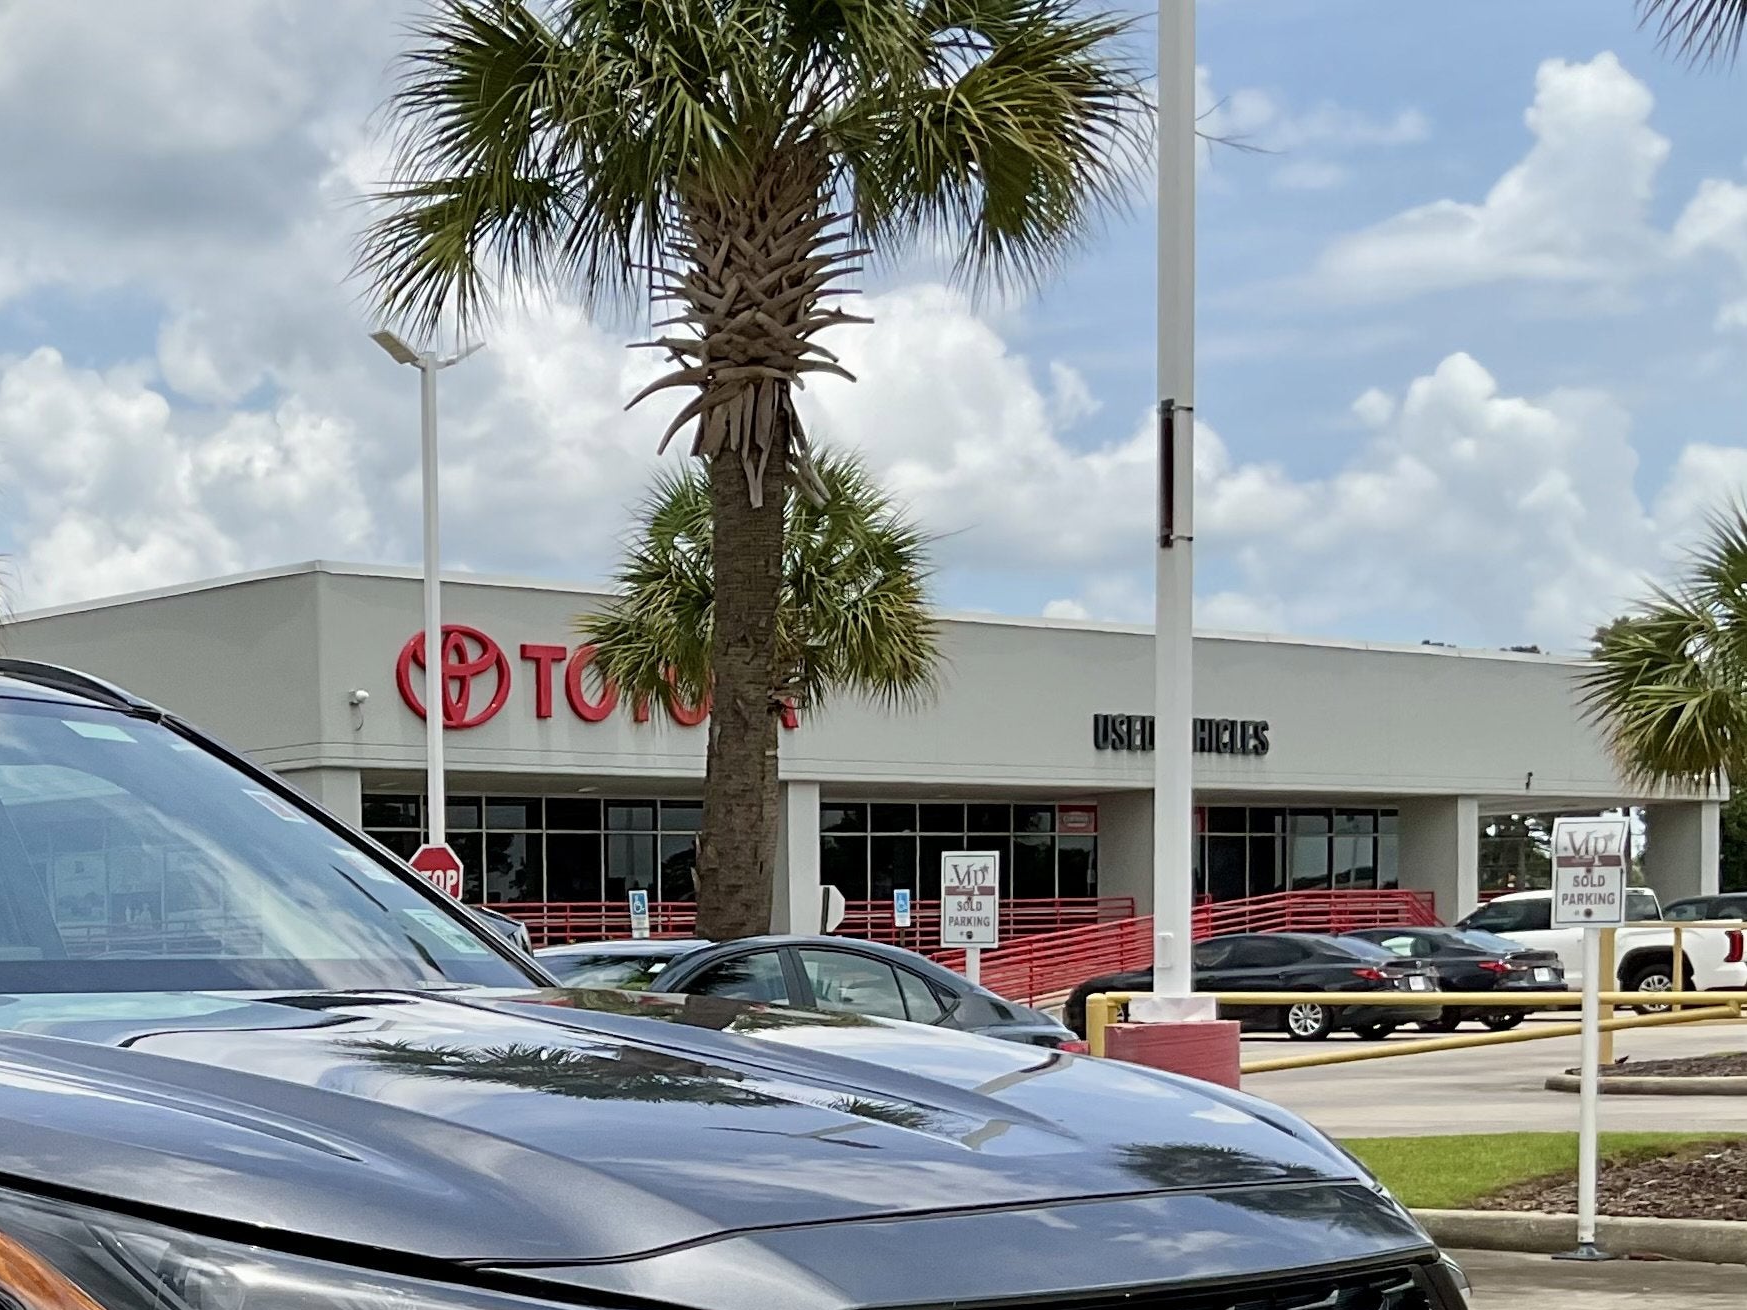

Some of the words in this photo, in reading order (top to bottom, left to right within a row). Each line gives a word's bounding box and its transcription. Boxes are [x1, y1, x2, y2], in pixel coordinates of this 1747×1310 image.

[1193, 718, 1269, 754] HICLES
[1573, 875, 1606, 887] SOLD
[1561, 892, 1616, 905] PARKING
[956, 901, 982, 911] SOLD
[948, 916, 990, 927] PARKING
